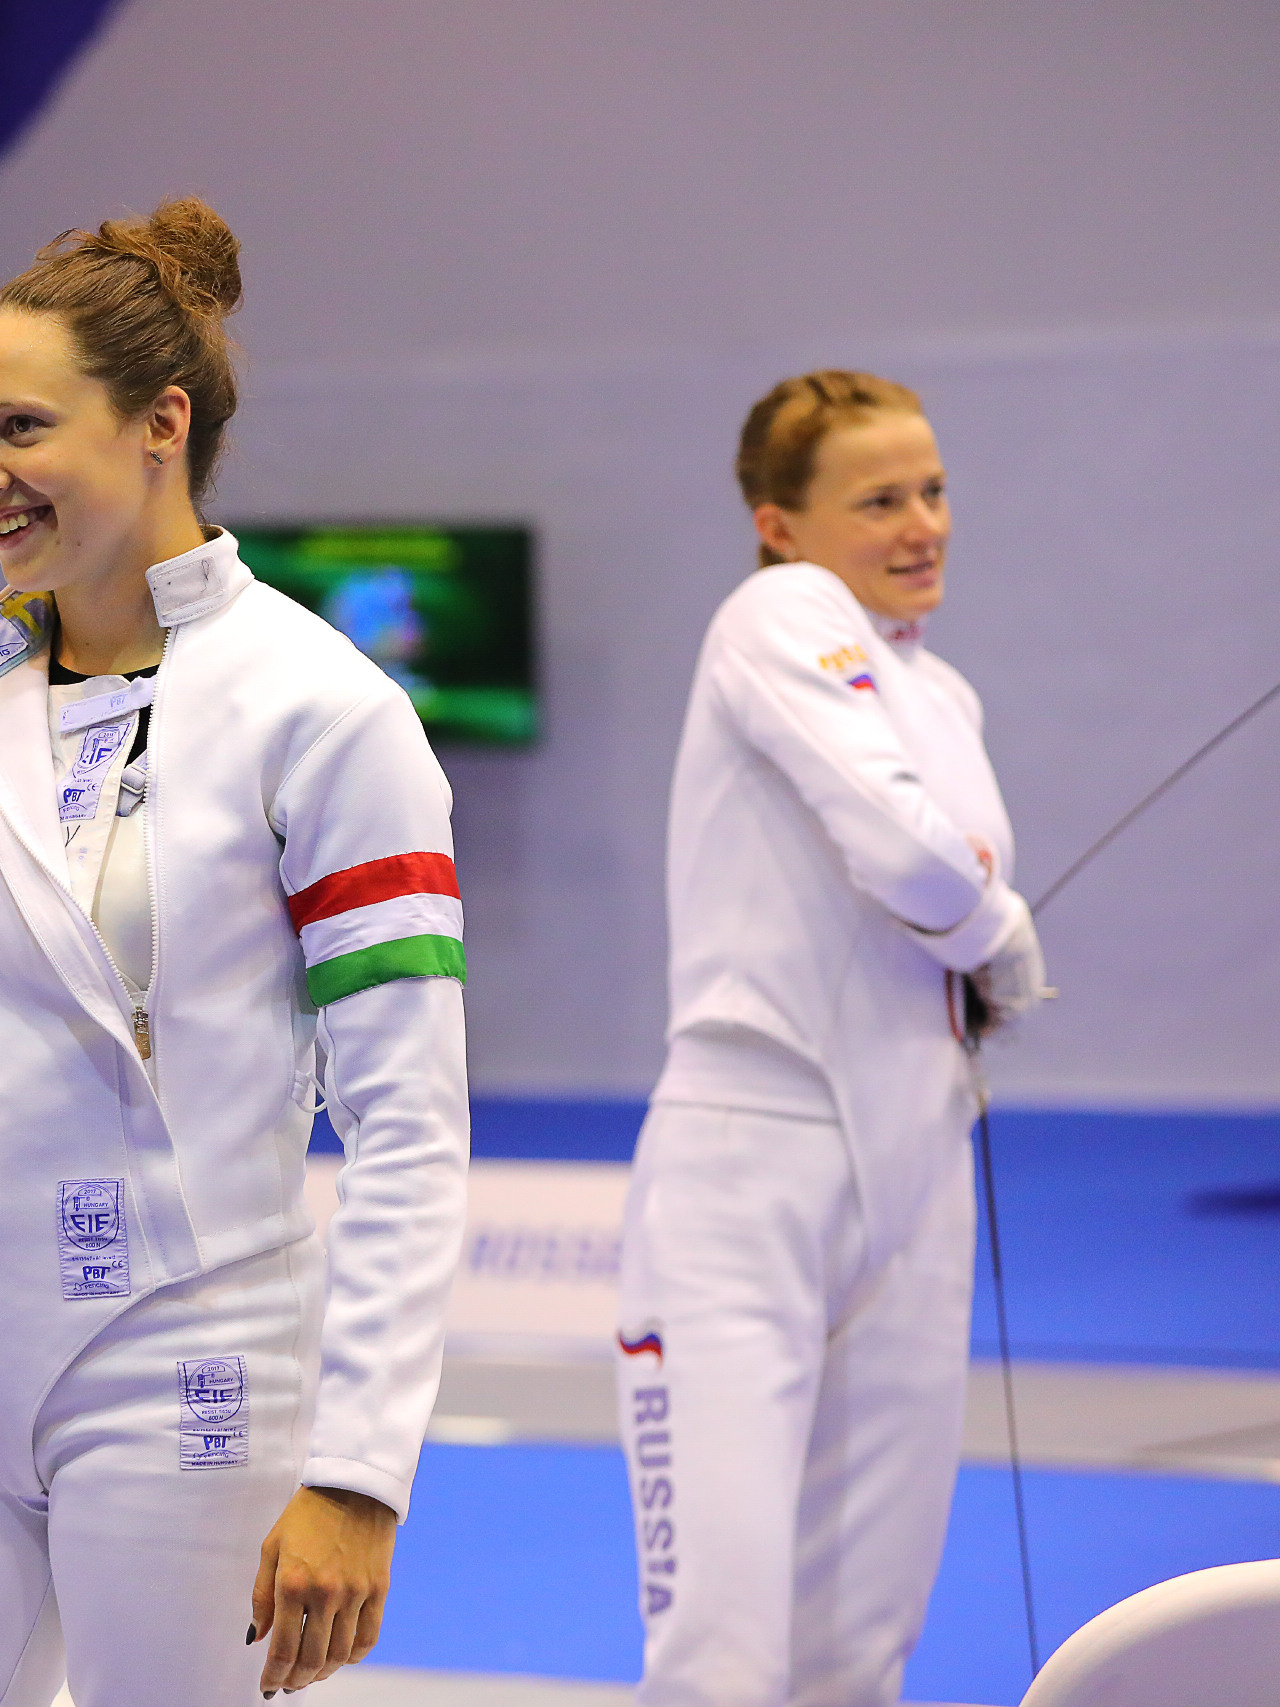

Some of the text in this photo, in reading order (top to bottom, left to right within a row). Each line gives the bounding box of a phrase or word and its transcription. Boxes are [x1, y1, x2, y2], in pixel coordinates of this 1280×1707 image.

[63, 787, 86, 804] PBT
[82, 1265, 111, 1281] PBT
[203, 1435, 232, 1451] PBT
[632, 1385, 676, 1618] RUSSIA
